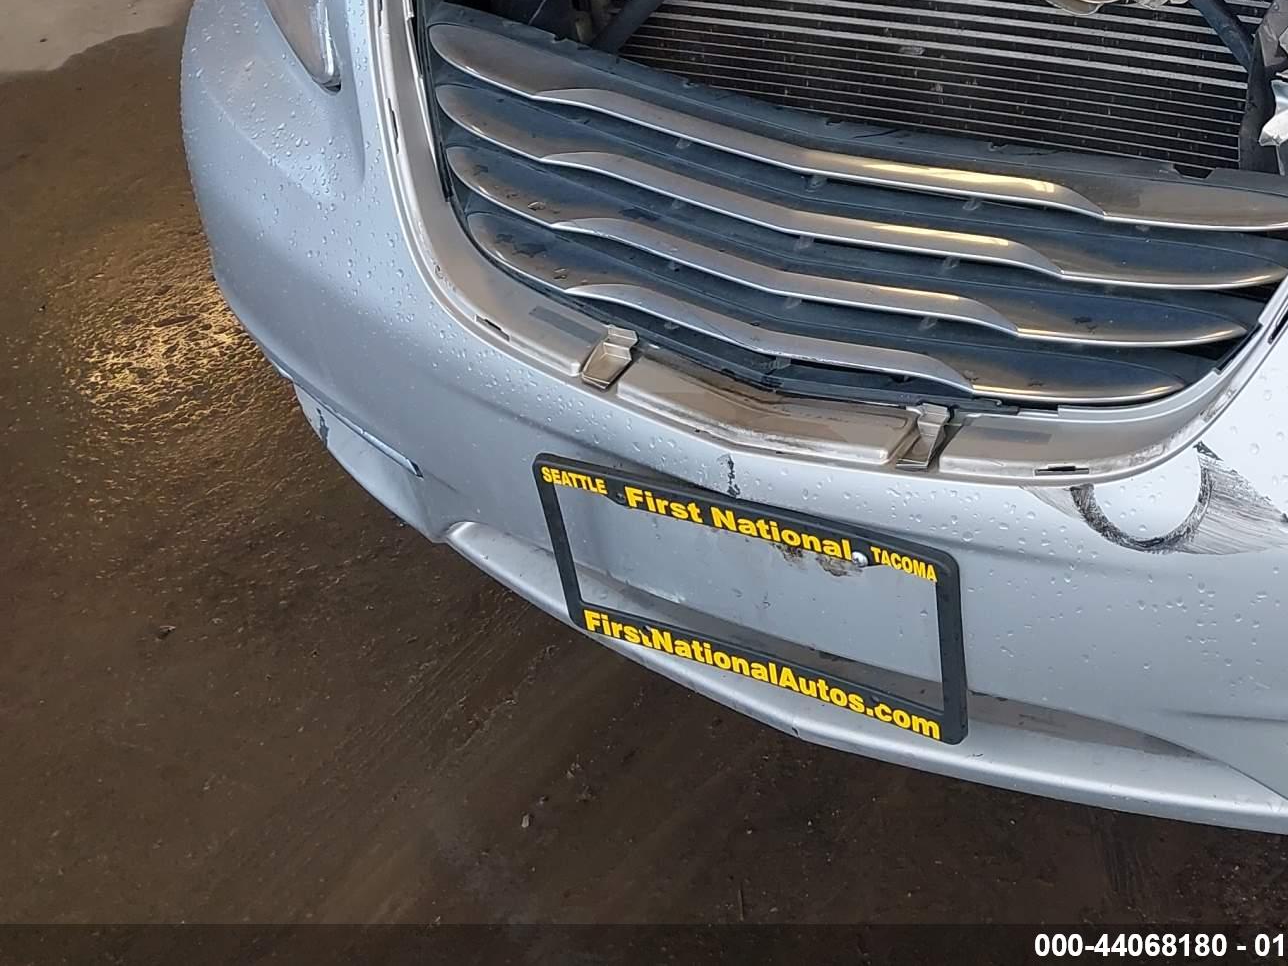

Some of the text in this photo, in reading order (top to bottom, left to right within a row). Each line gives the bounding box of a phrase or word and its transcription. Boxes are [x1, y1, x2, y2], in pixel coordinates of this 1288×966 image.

[540, 466, 608, 495] SEATTLE
[624, 486, 853, 562] First National
[870, 546, 938, 582] TACOMA
[583, 609, 942, 741] FirstNationalAutos.com
